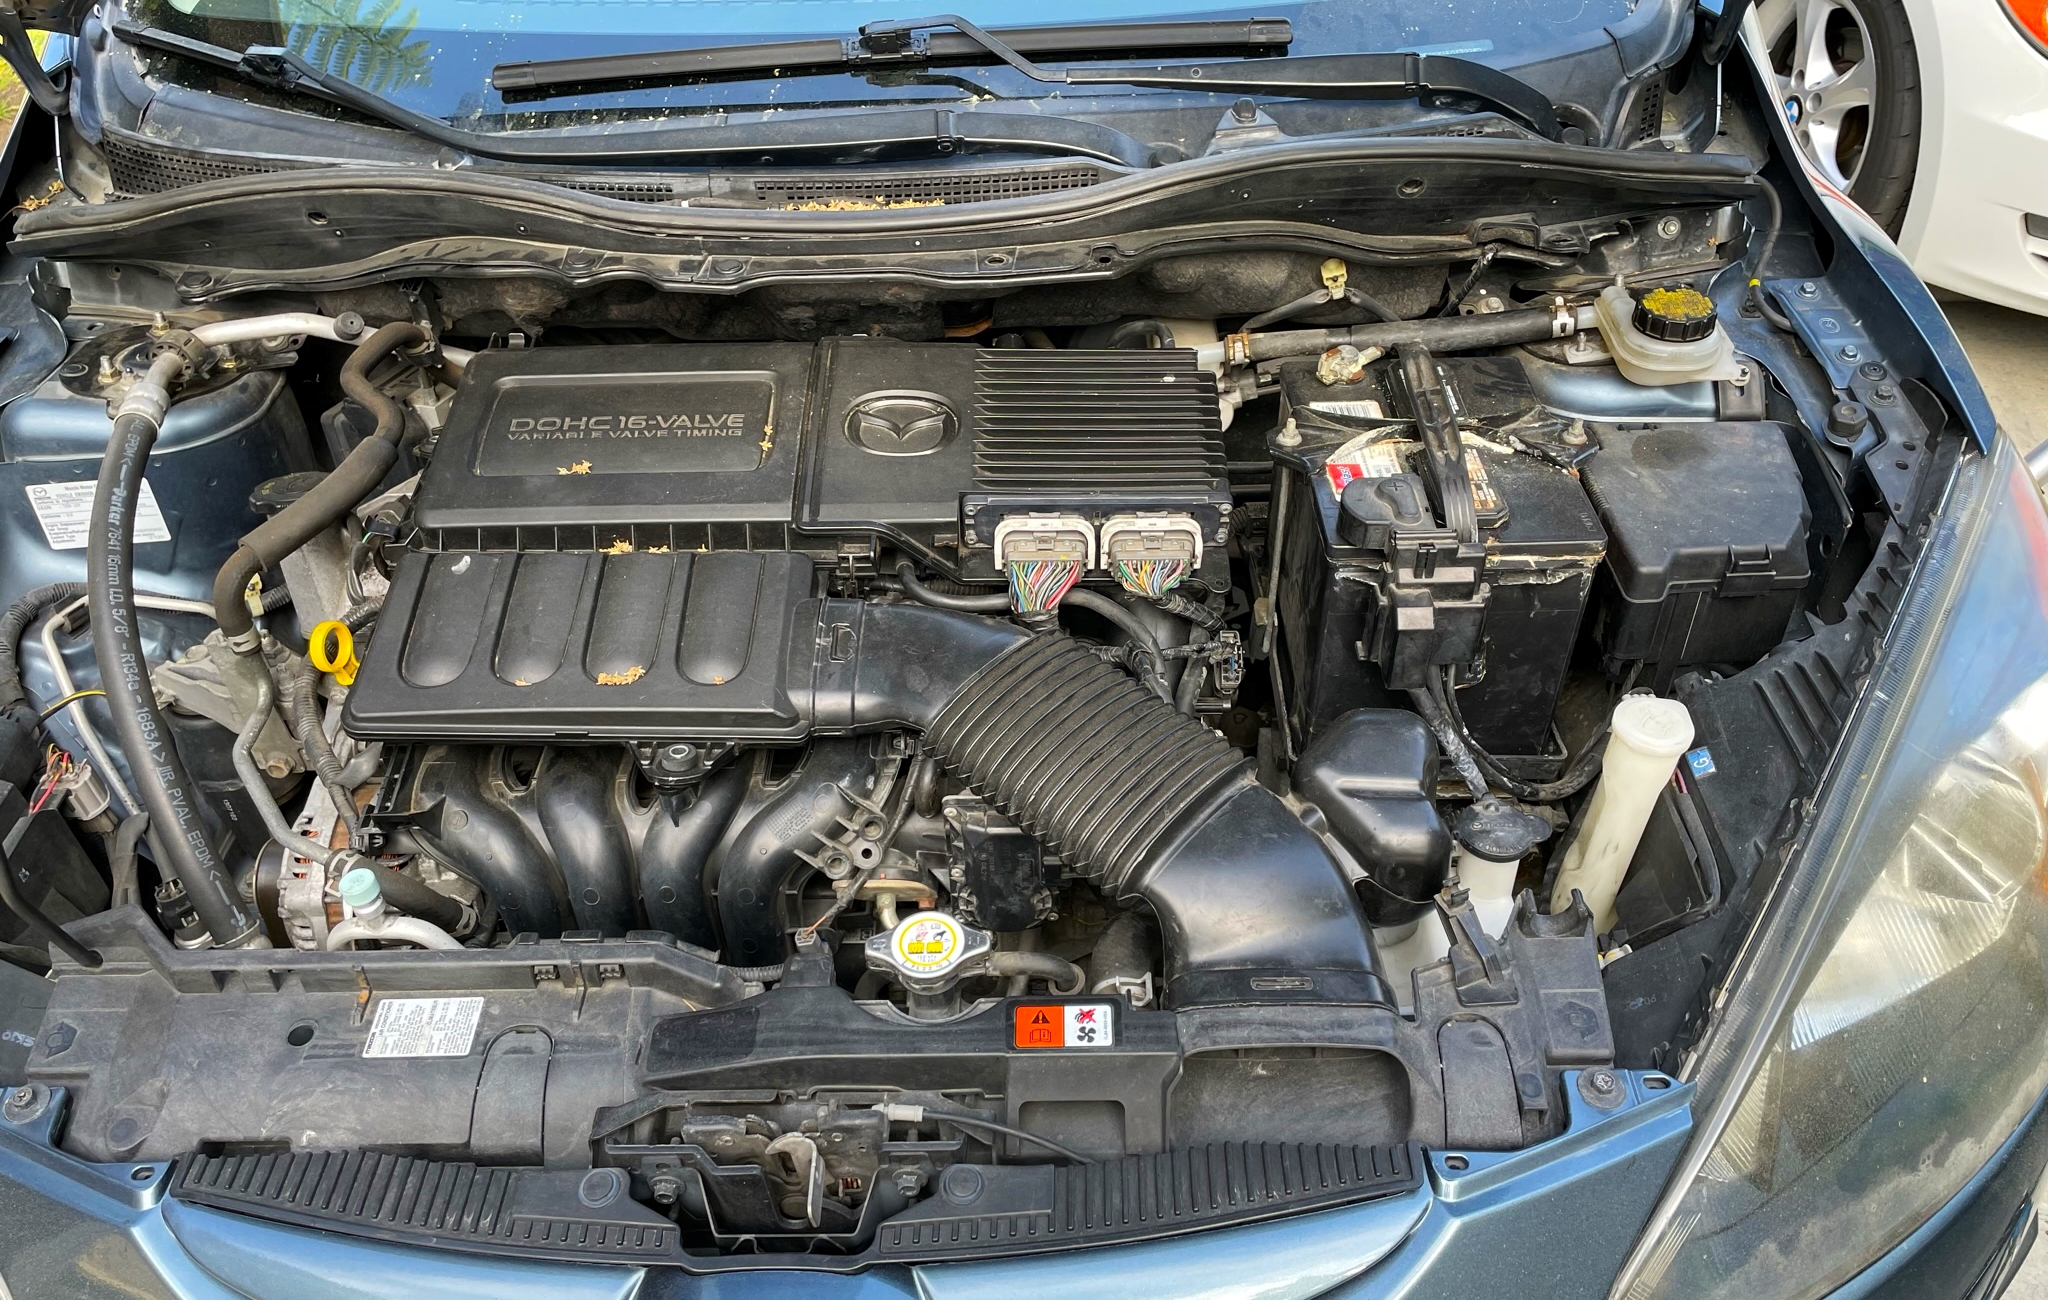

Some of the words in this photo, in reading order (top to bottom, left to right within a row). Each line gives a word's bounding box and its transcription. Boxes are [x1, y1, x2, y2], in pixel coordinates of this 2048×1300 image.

[509, 416, 613, 432] DOHC
[618, 413, 746, 429] 16-VALVE
[608, 429, 669, 438] VALVE
[673, 428, 743, 437] TIMING
[108, 525, 122, 551] 7641
[107, 554, 122, 585] 16mm
[120, 653, 141, 691] R134a
[135, 707, 162, 750] 1683A
